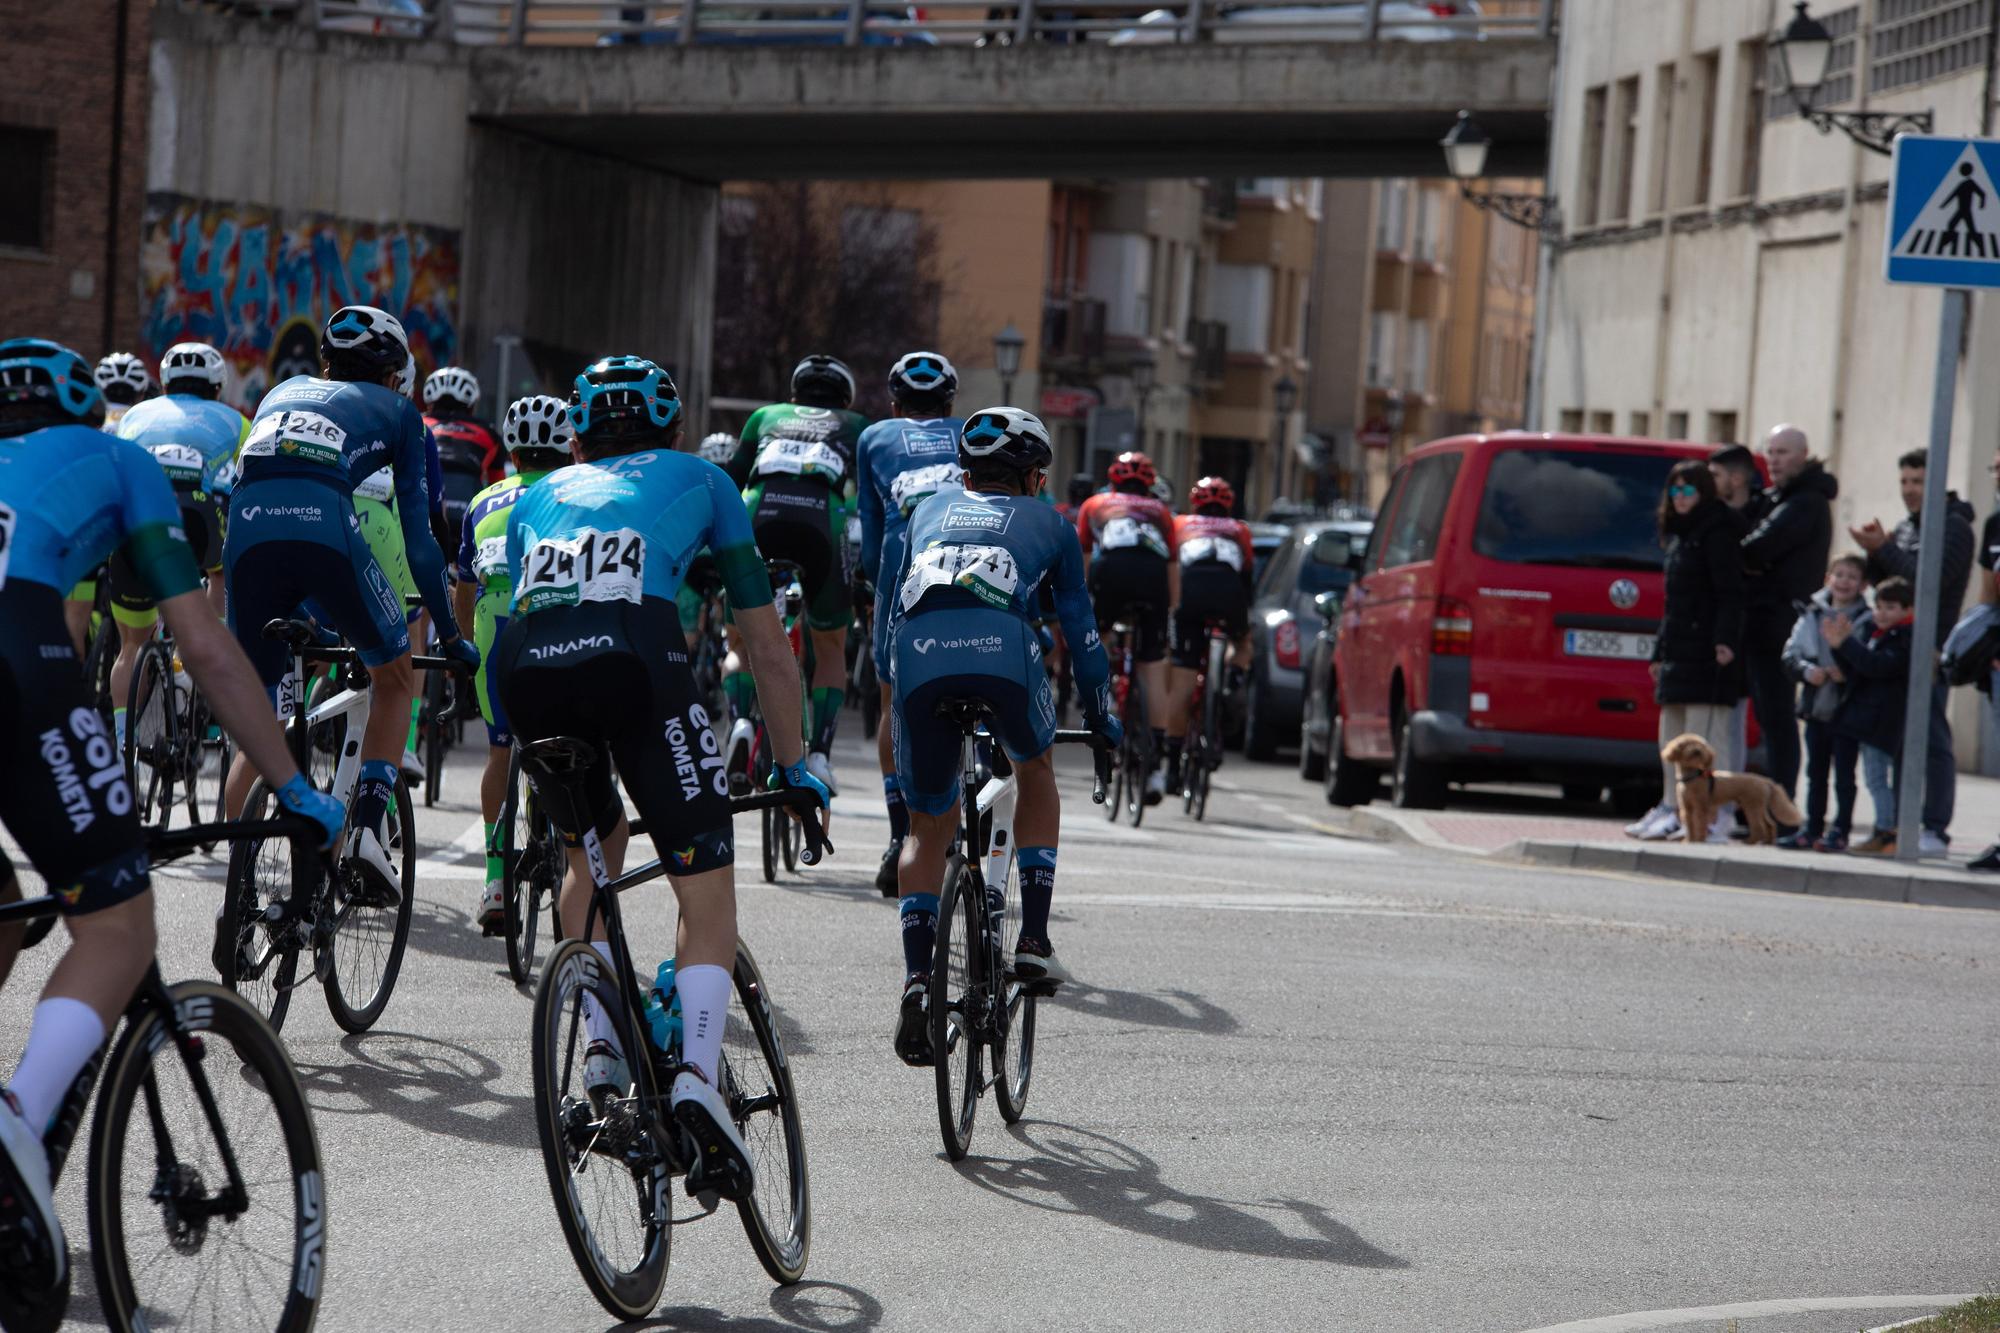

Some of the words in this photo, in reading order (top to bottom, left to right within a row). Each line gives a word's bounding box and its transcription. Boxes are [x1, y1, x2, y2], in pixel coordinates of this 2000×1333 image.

[288, 416, 340, 443] 246
[910, 439, 952, 448] Ricardo
[316, 449, 338, 462] RURAL
[265, 506, 322, 516] valverde
[949, 514, 1003, 524] Ricardo
[947, 520, 1001, 529] Fuentes
[579, 534, 642, 582] 124
[966, 552, 1012, 579] 241
[987, 591, 1009, 606] RURAL
[941, 635, 1003, 648] valverde
[1579, 636, 1623, 653] 2905
[281, 680, 294, 714] 246
[664, 716, 702, 802] KOMETA
[688, 702, 730, 797] eolo
[69, 706, 132, 816] eolo
[39, 728, 96, 834] KOMETA
